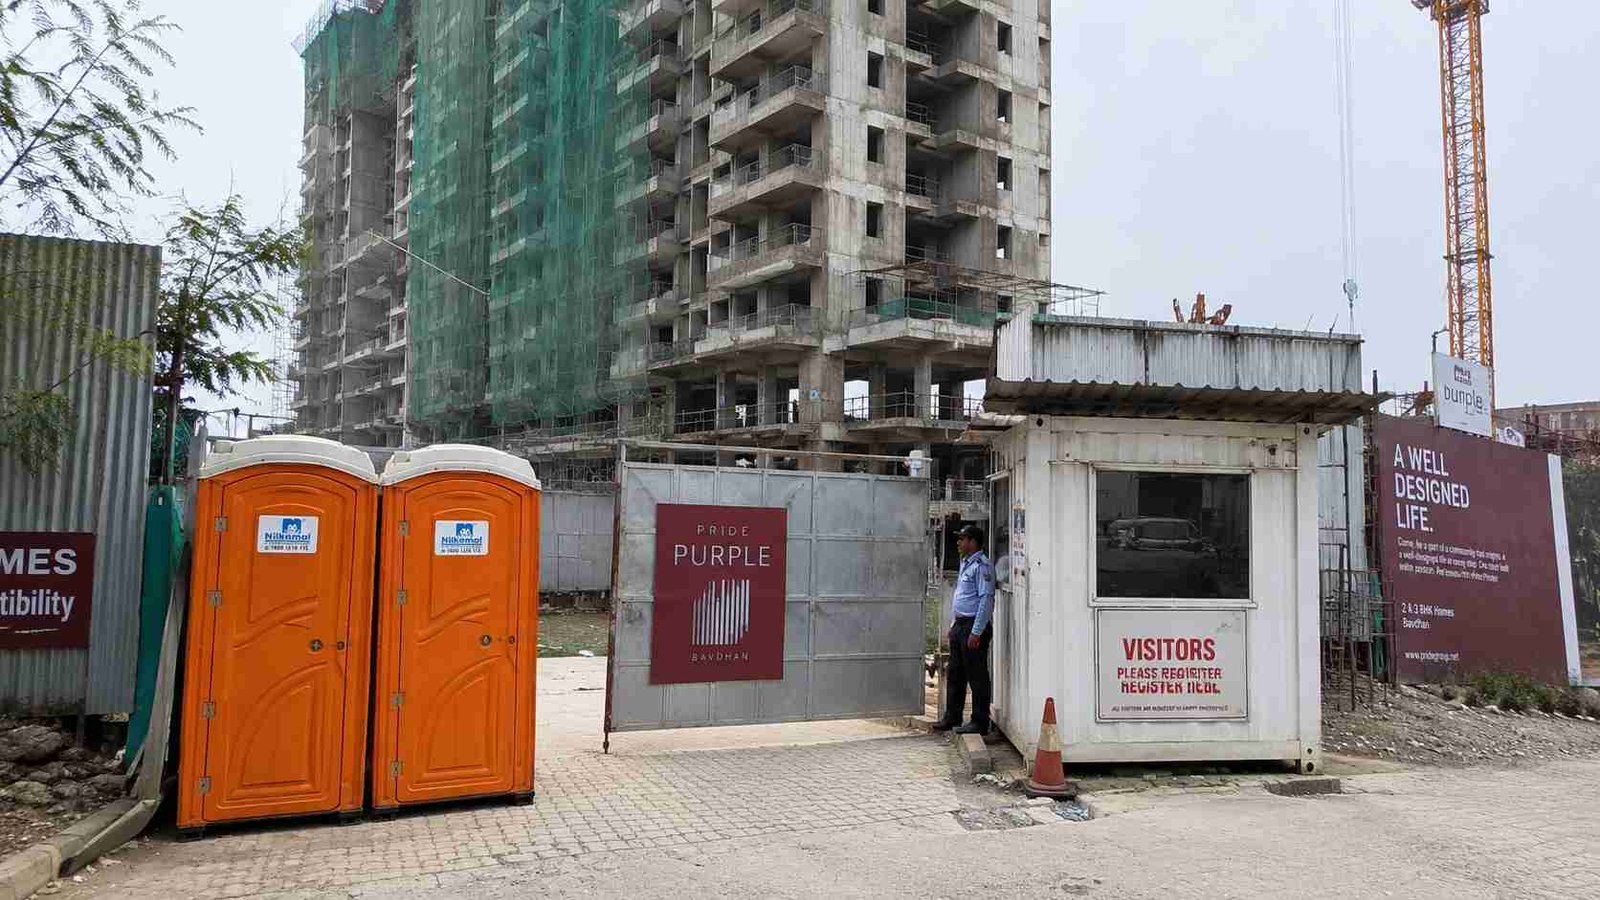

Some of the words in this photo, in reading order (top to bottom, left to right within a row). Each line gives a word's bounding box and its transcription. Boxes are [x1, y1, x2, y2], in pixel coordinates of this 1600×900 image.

[1393, 443, 1405, 469] A
[1407, 445, 1449, 477] WELL
[1395, 472, 1470, 509] DESIGNED
[697, 524, 750, 537] PRIDE
[1396, 502, 1434, 533] LIFE.
[264, 532, 311, 541] Nilkamal
[0, 548, 77, 575] MES
[674, 544, 771, 567] PURPLE
[0, 589, 75, 622] tibility
[1122, 637, 1216, 661] VISITORS
